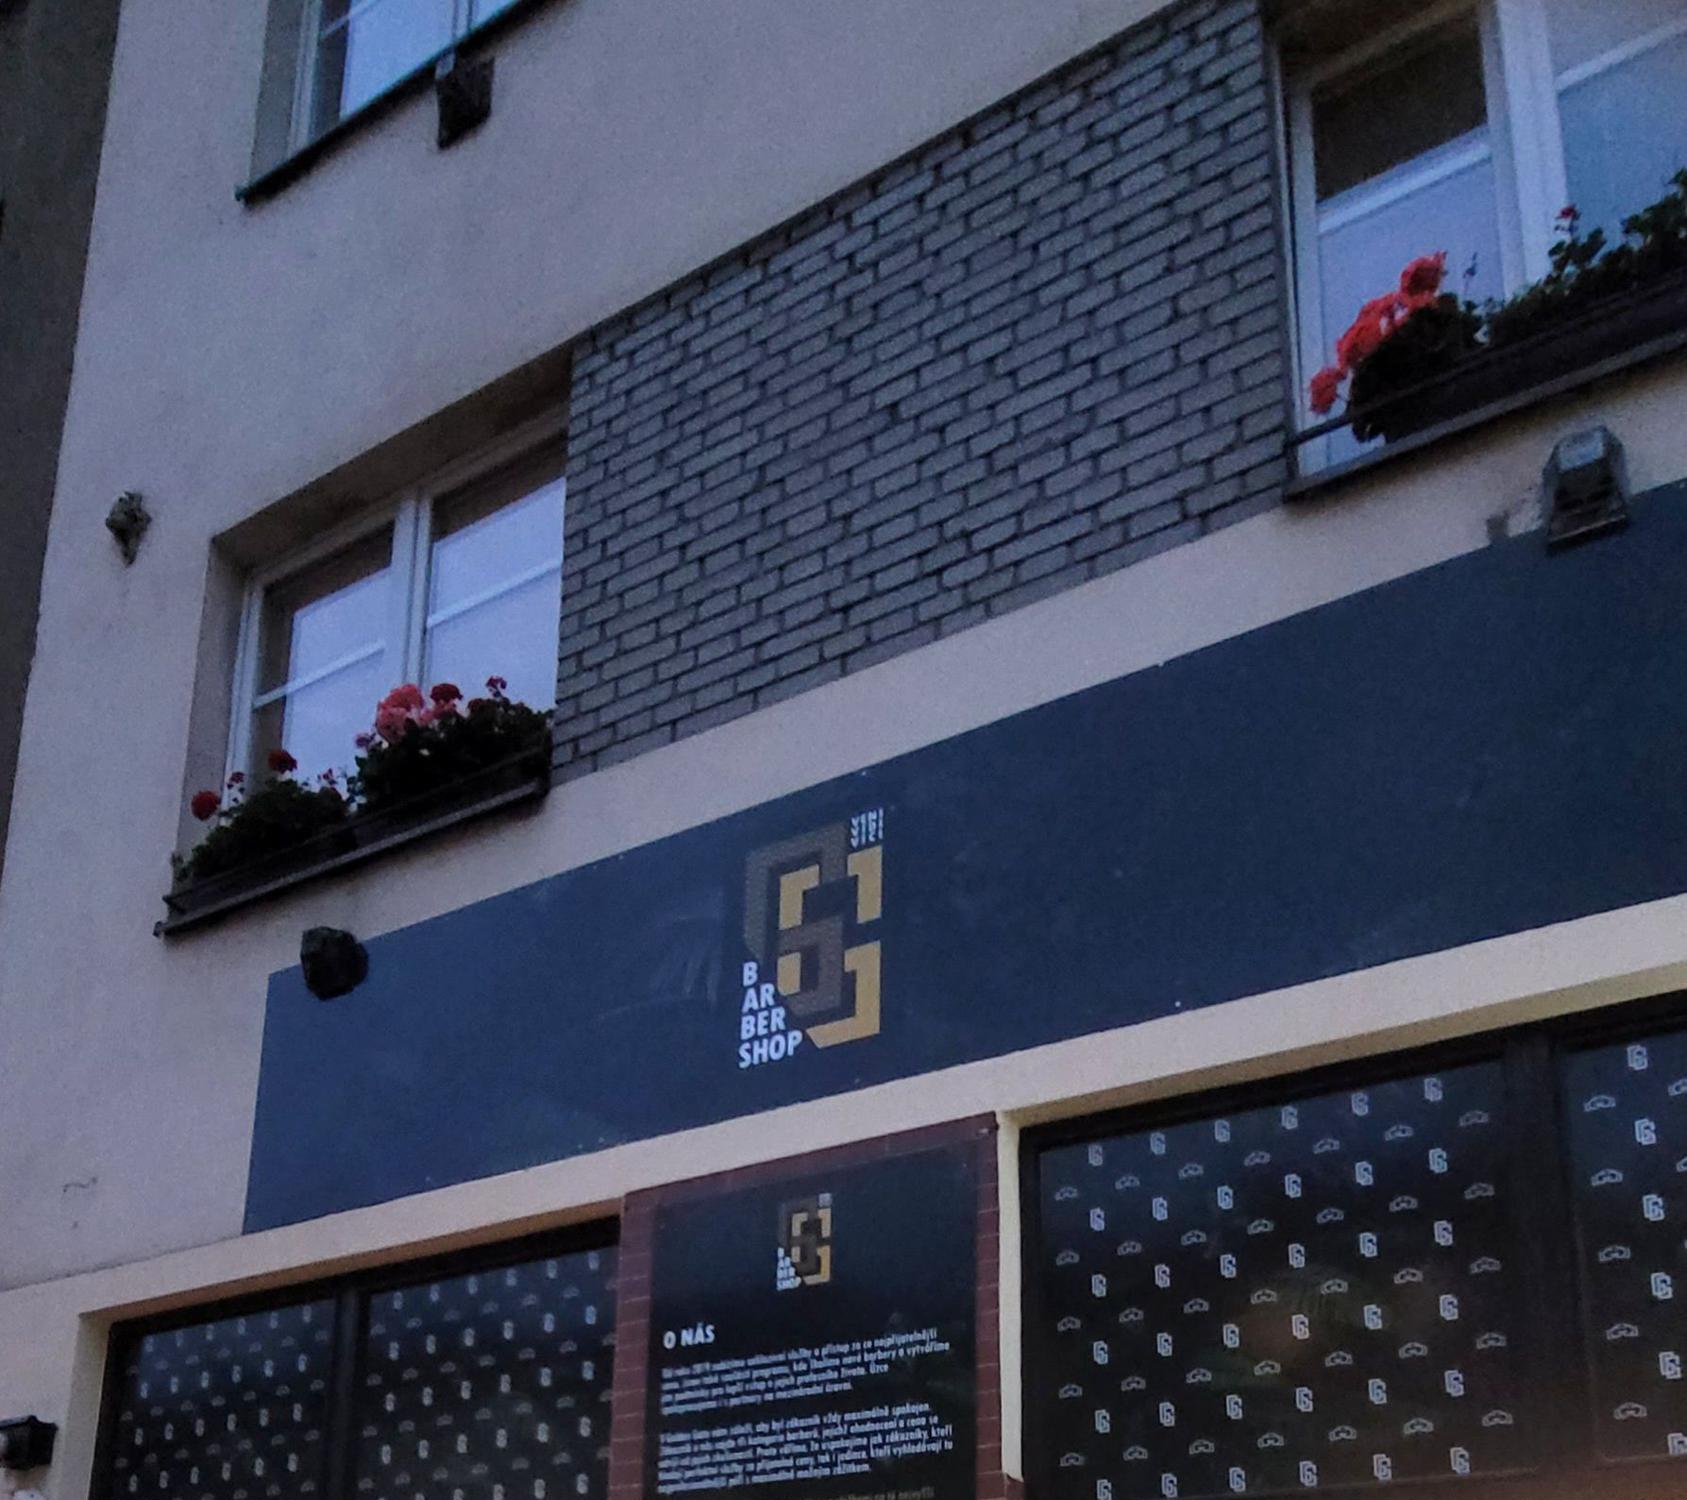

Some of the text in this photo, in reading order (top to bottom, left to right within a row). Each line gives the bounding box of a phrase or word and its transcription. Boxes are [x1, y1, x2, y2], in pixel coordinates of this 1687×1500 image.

[742, 983, 775, 1013] AR
[740, 1006, 786, 1041] BER
[738, 1030, 803, 1069] SHOP
[663, 1322, 715, 1349] O NÁS
